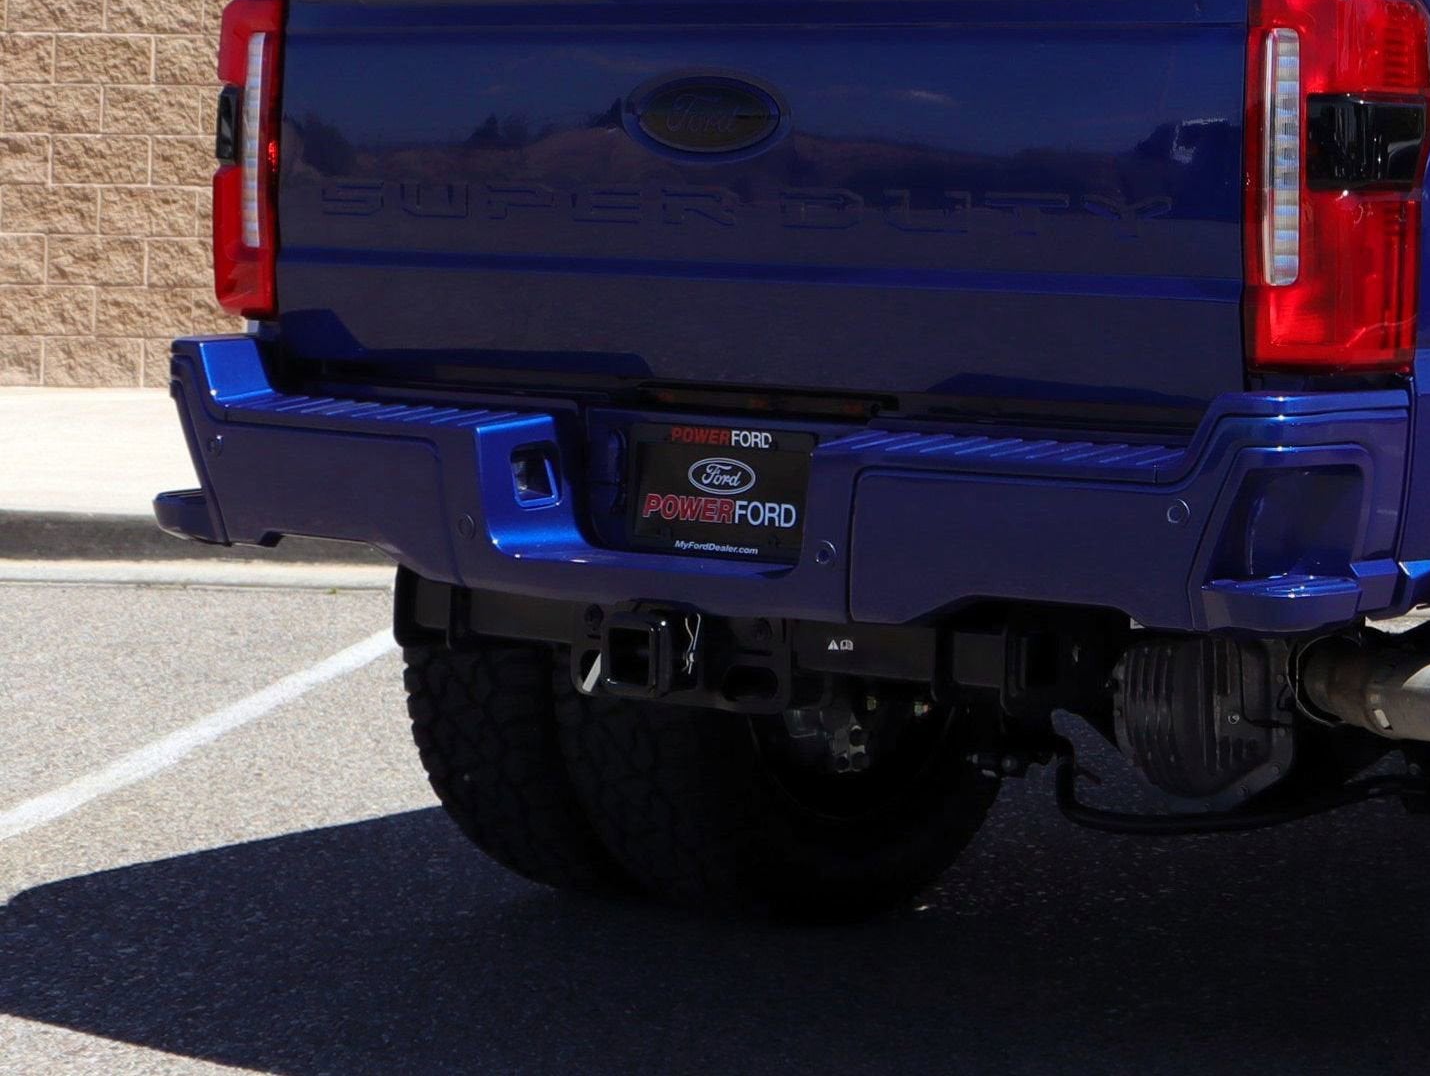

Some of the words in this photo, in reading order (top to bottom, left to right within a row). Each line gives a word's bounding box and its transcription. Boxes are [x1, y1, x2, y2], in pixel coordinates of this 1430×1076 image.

[319, 180, 739, 228] SUPER
[778, 185, 1177, 239] DUTY
[702, 463, 742, 487] Ford
[674, 539, 759, 556] MyFordDealer.com
